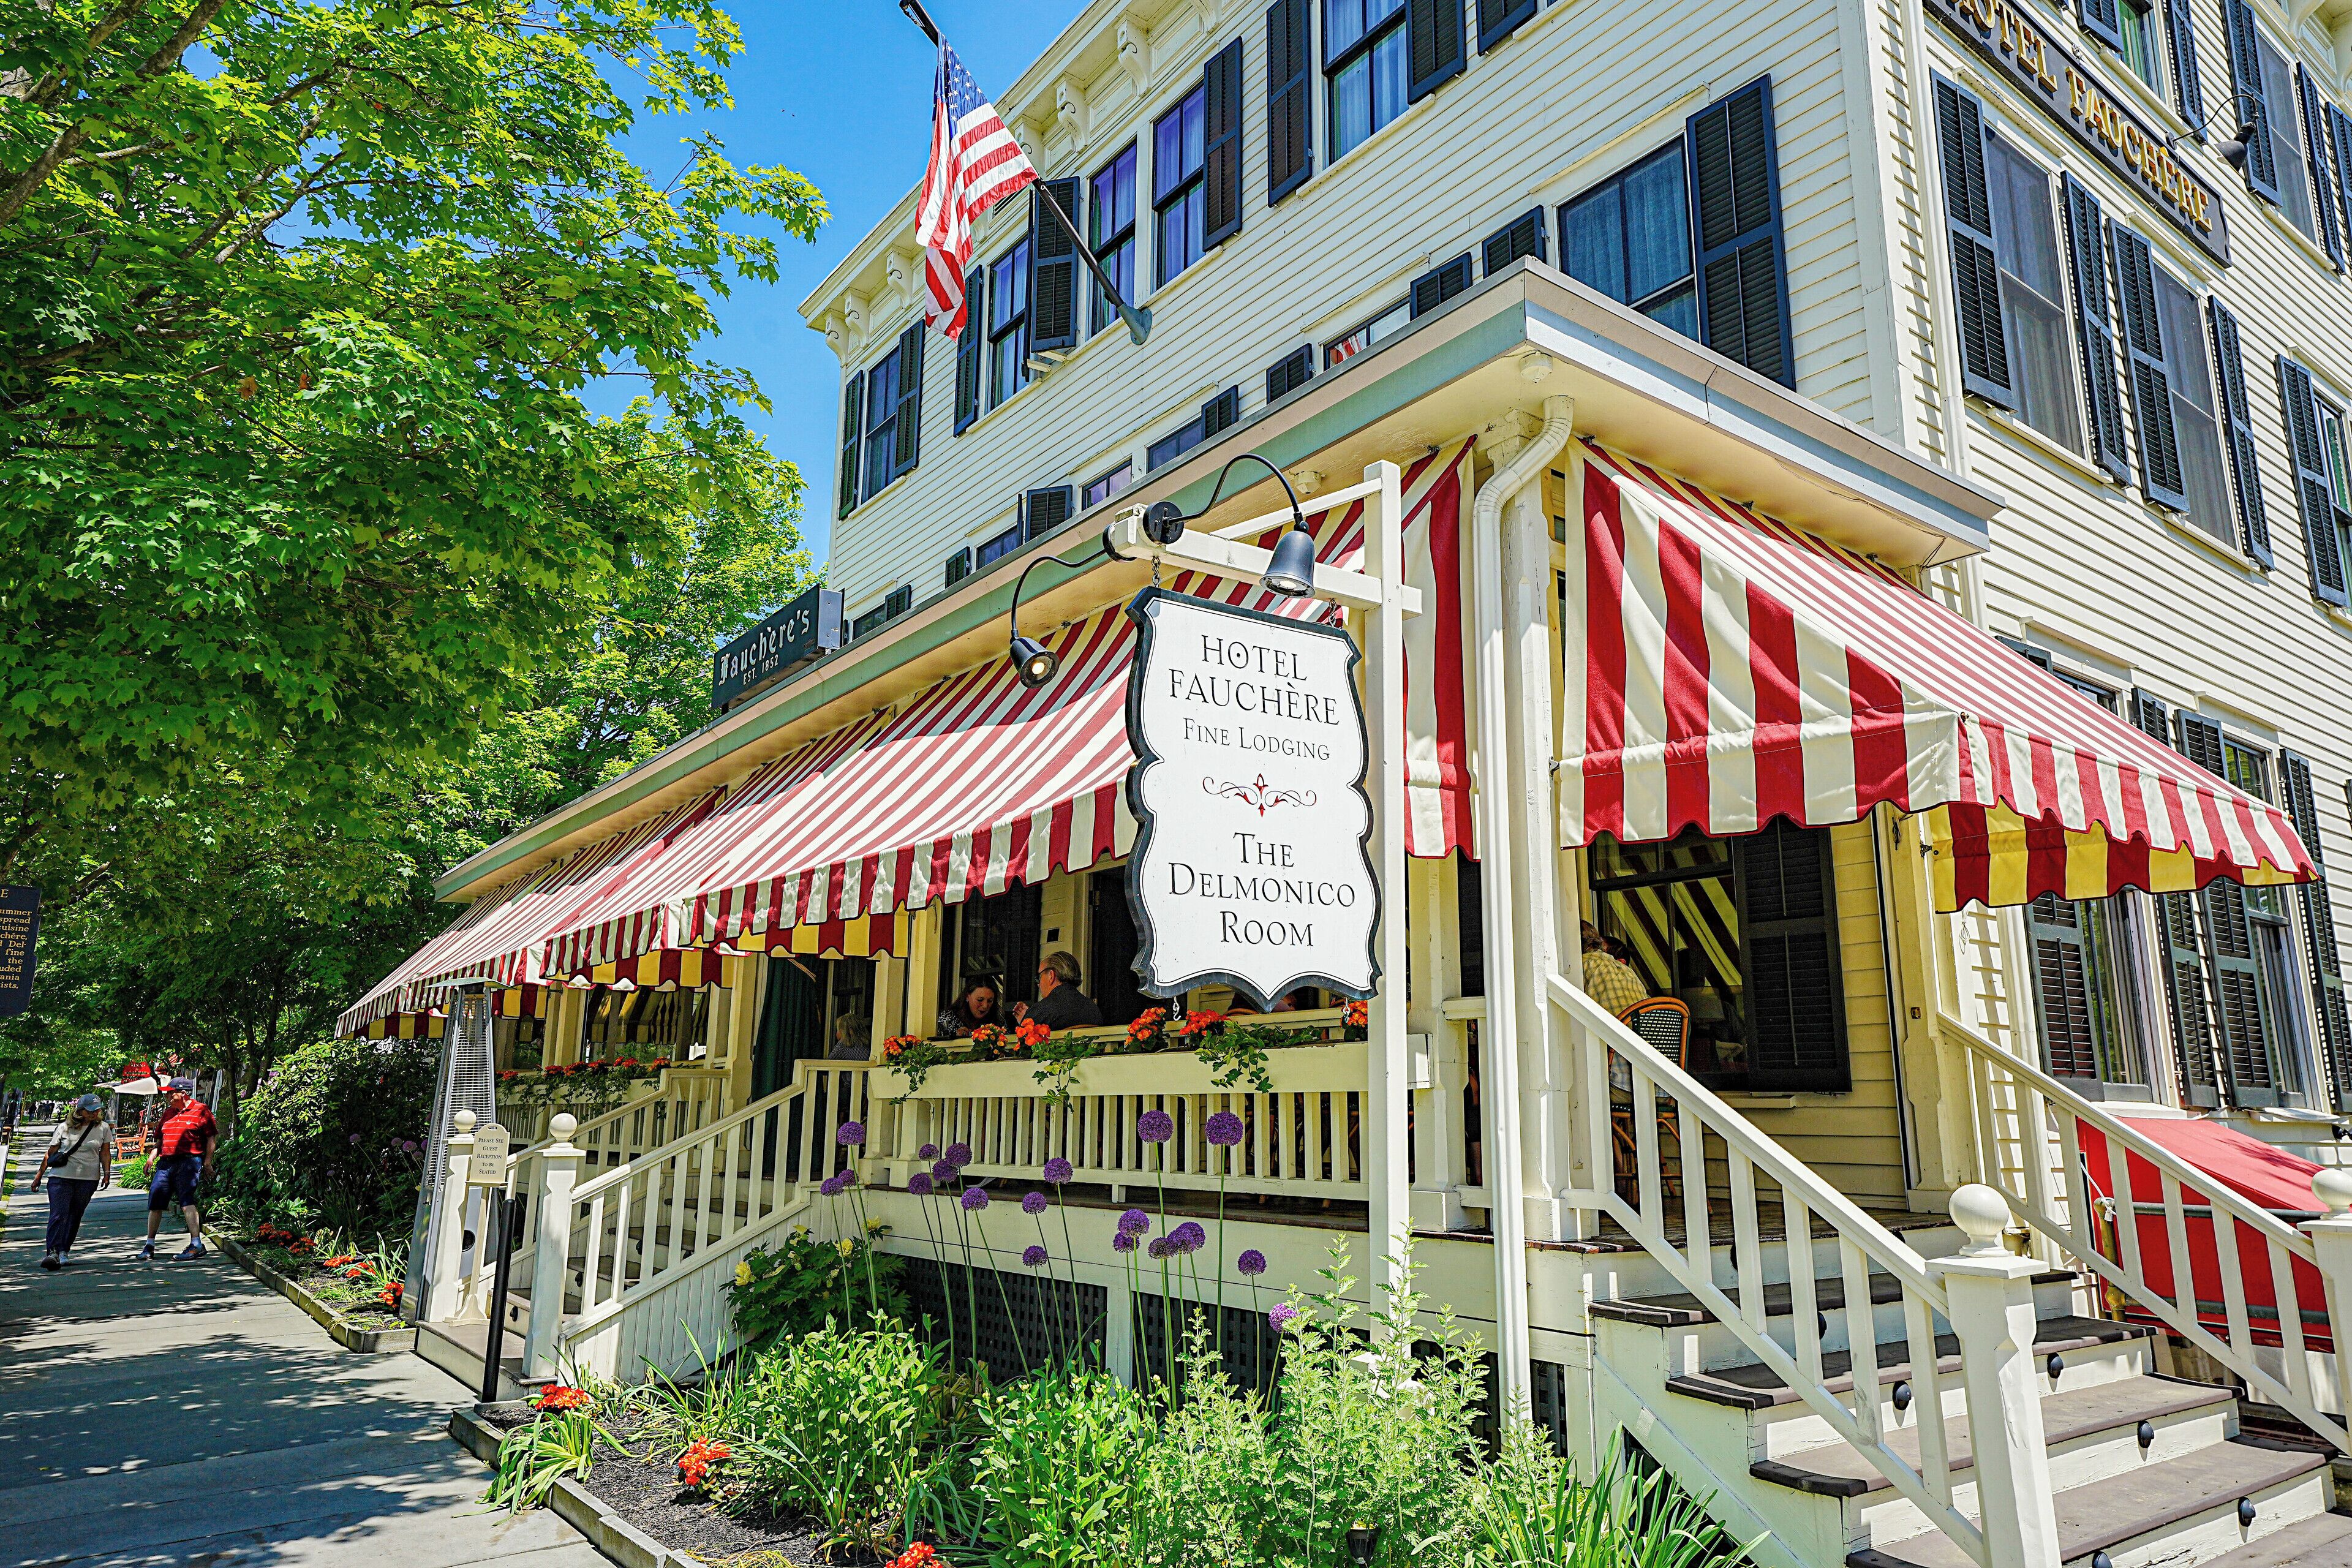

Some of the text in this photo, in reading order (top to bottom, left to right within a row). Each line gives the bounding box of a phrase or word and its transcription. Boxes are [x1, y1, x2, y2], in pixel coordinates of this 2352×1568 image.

[1948, 0, 2212, 232] OTEL FAUCHÈRE
[743, 654, 778, 685] EST. 1852
[1201, 635, 1308, 681] HOTEL
[1169, 668, 1340, 725] FAUCHÈRE
